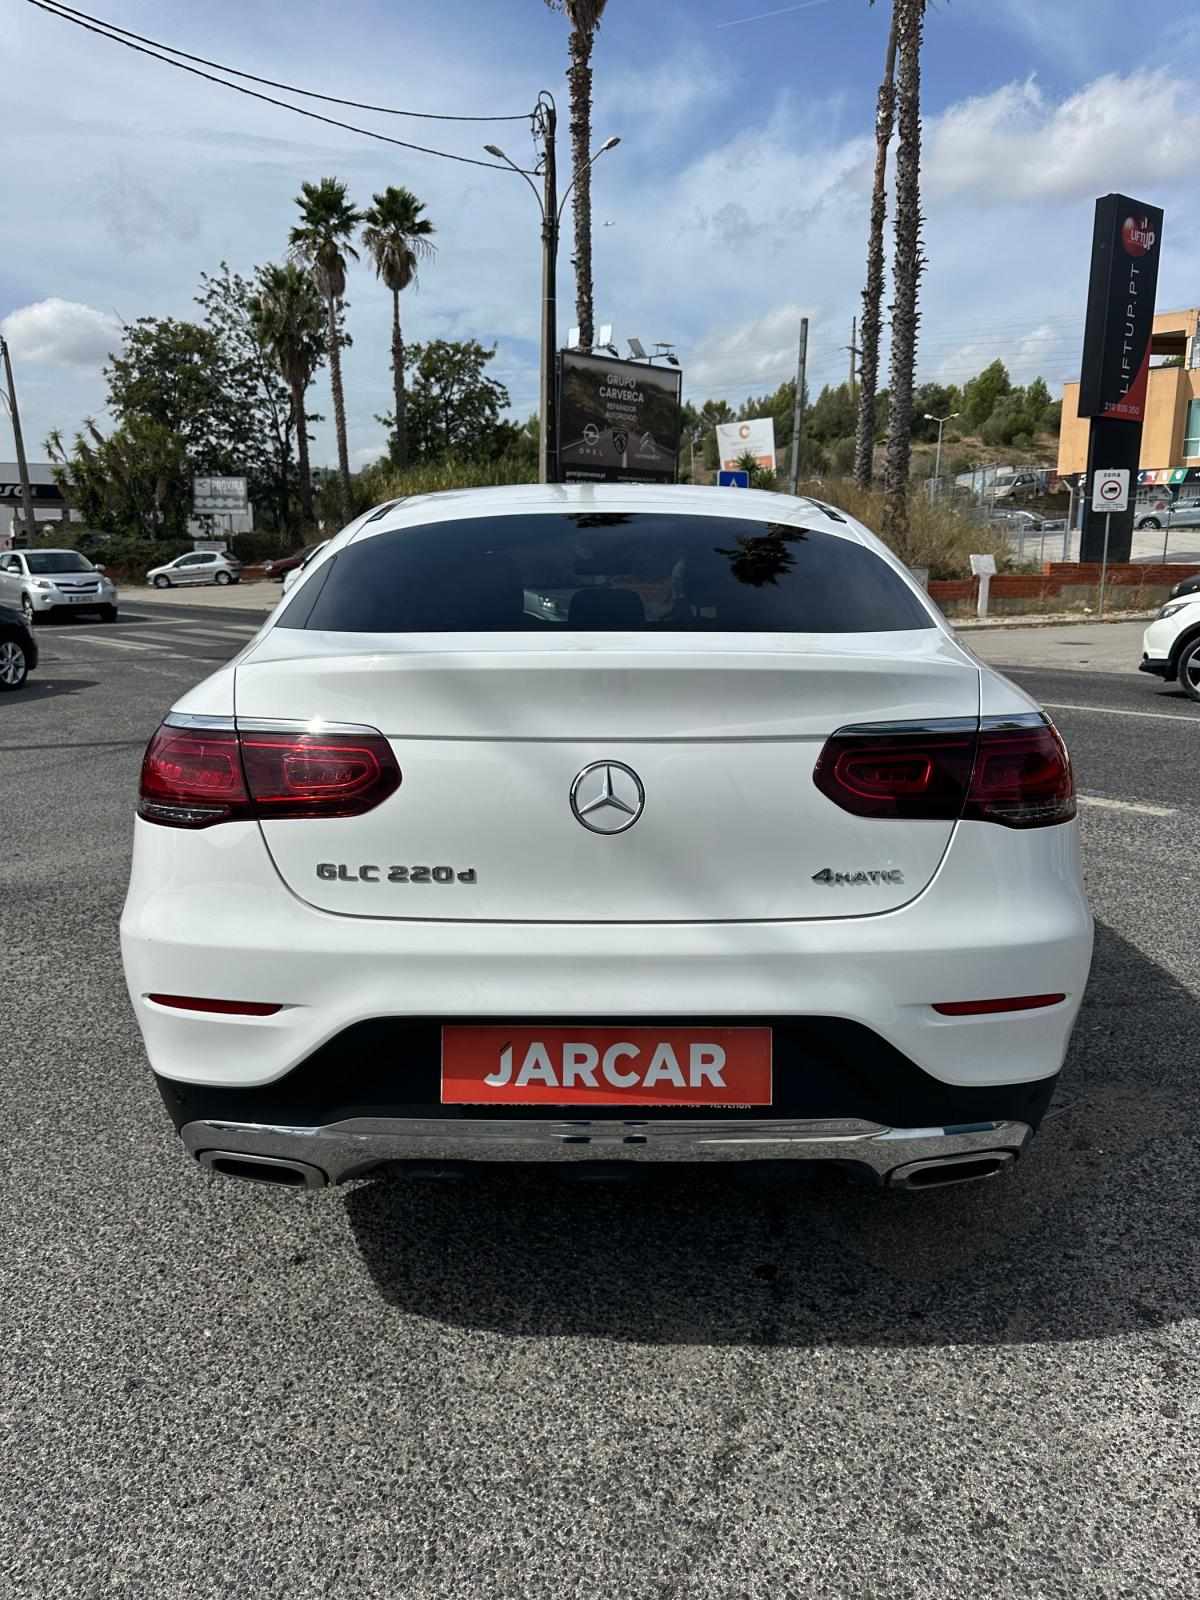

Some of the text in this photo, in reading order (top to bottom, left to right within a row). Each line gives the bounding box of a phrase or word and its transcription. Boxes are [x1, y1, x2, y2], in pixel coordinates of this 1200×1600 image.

[1119, 264, 1140, 394] LIFTUP.PT
[607, 374, 637, 389] GRUPO
[599, 386, 645, 403] CARVERCA
[316, 863, 477, 884] GLC 220d
[811, 868, 905, 886] 4MATIC
[483, 1041, 727, 1088] JARCAR
